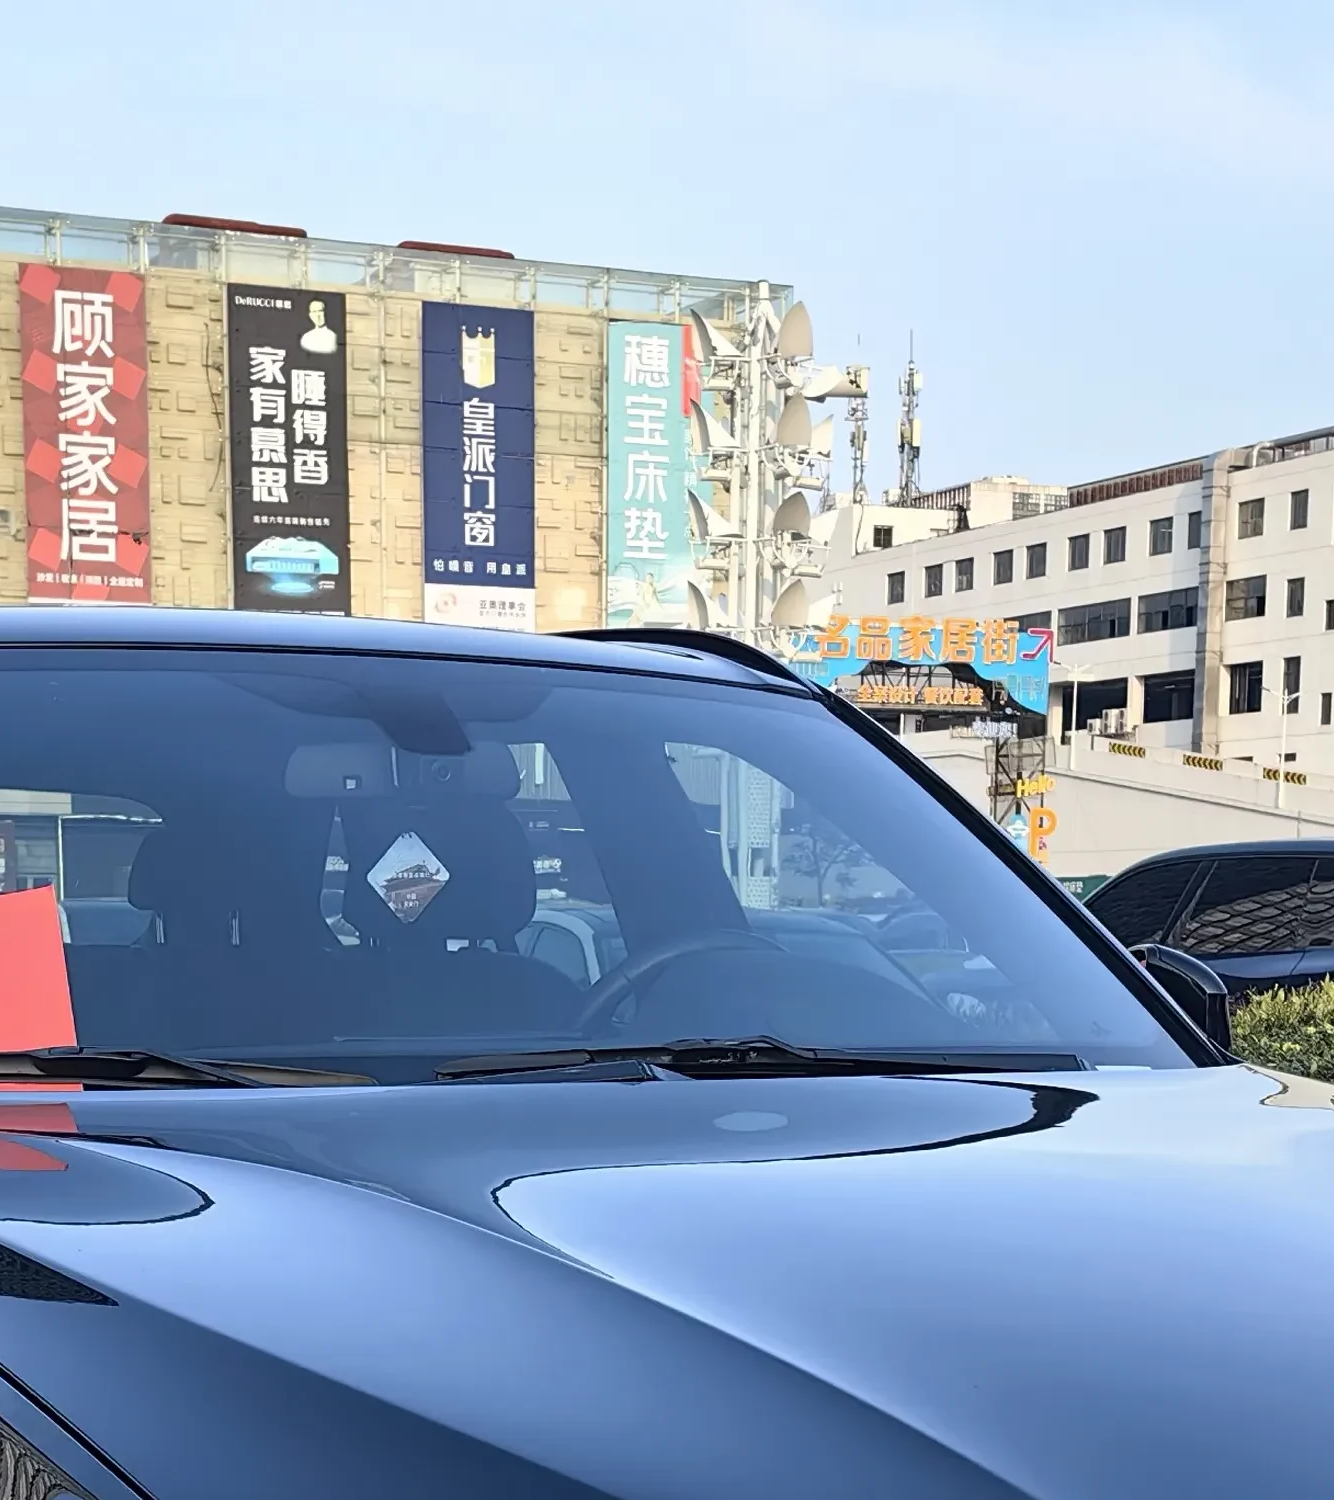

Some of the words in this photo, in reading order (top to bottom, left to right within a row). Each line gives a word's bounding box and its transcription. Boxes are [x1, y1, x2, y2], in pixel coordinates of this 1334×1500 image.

[51, 288, 118, 563] 顾家家居
[248, 346, 289, 503] 家有慕思
[291, 368, 329, 487] 睡得香
[461, 397, 496, 547] 皇派门窗
[623, 334, 671, 560] 穗宝床垫
[815, 613, 1020, 666] 名品家居街
[1016, 774, 1057, 799] Hello
